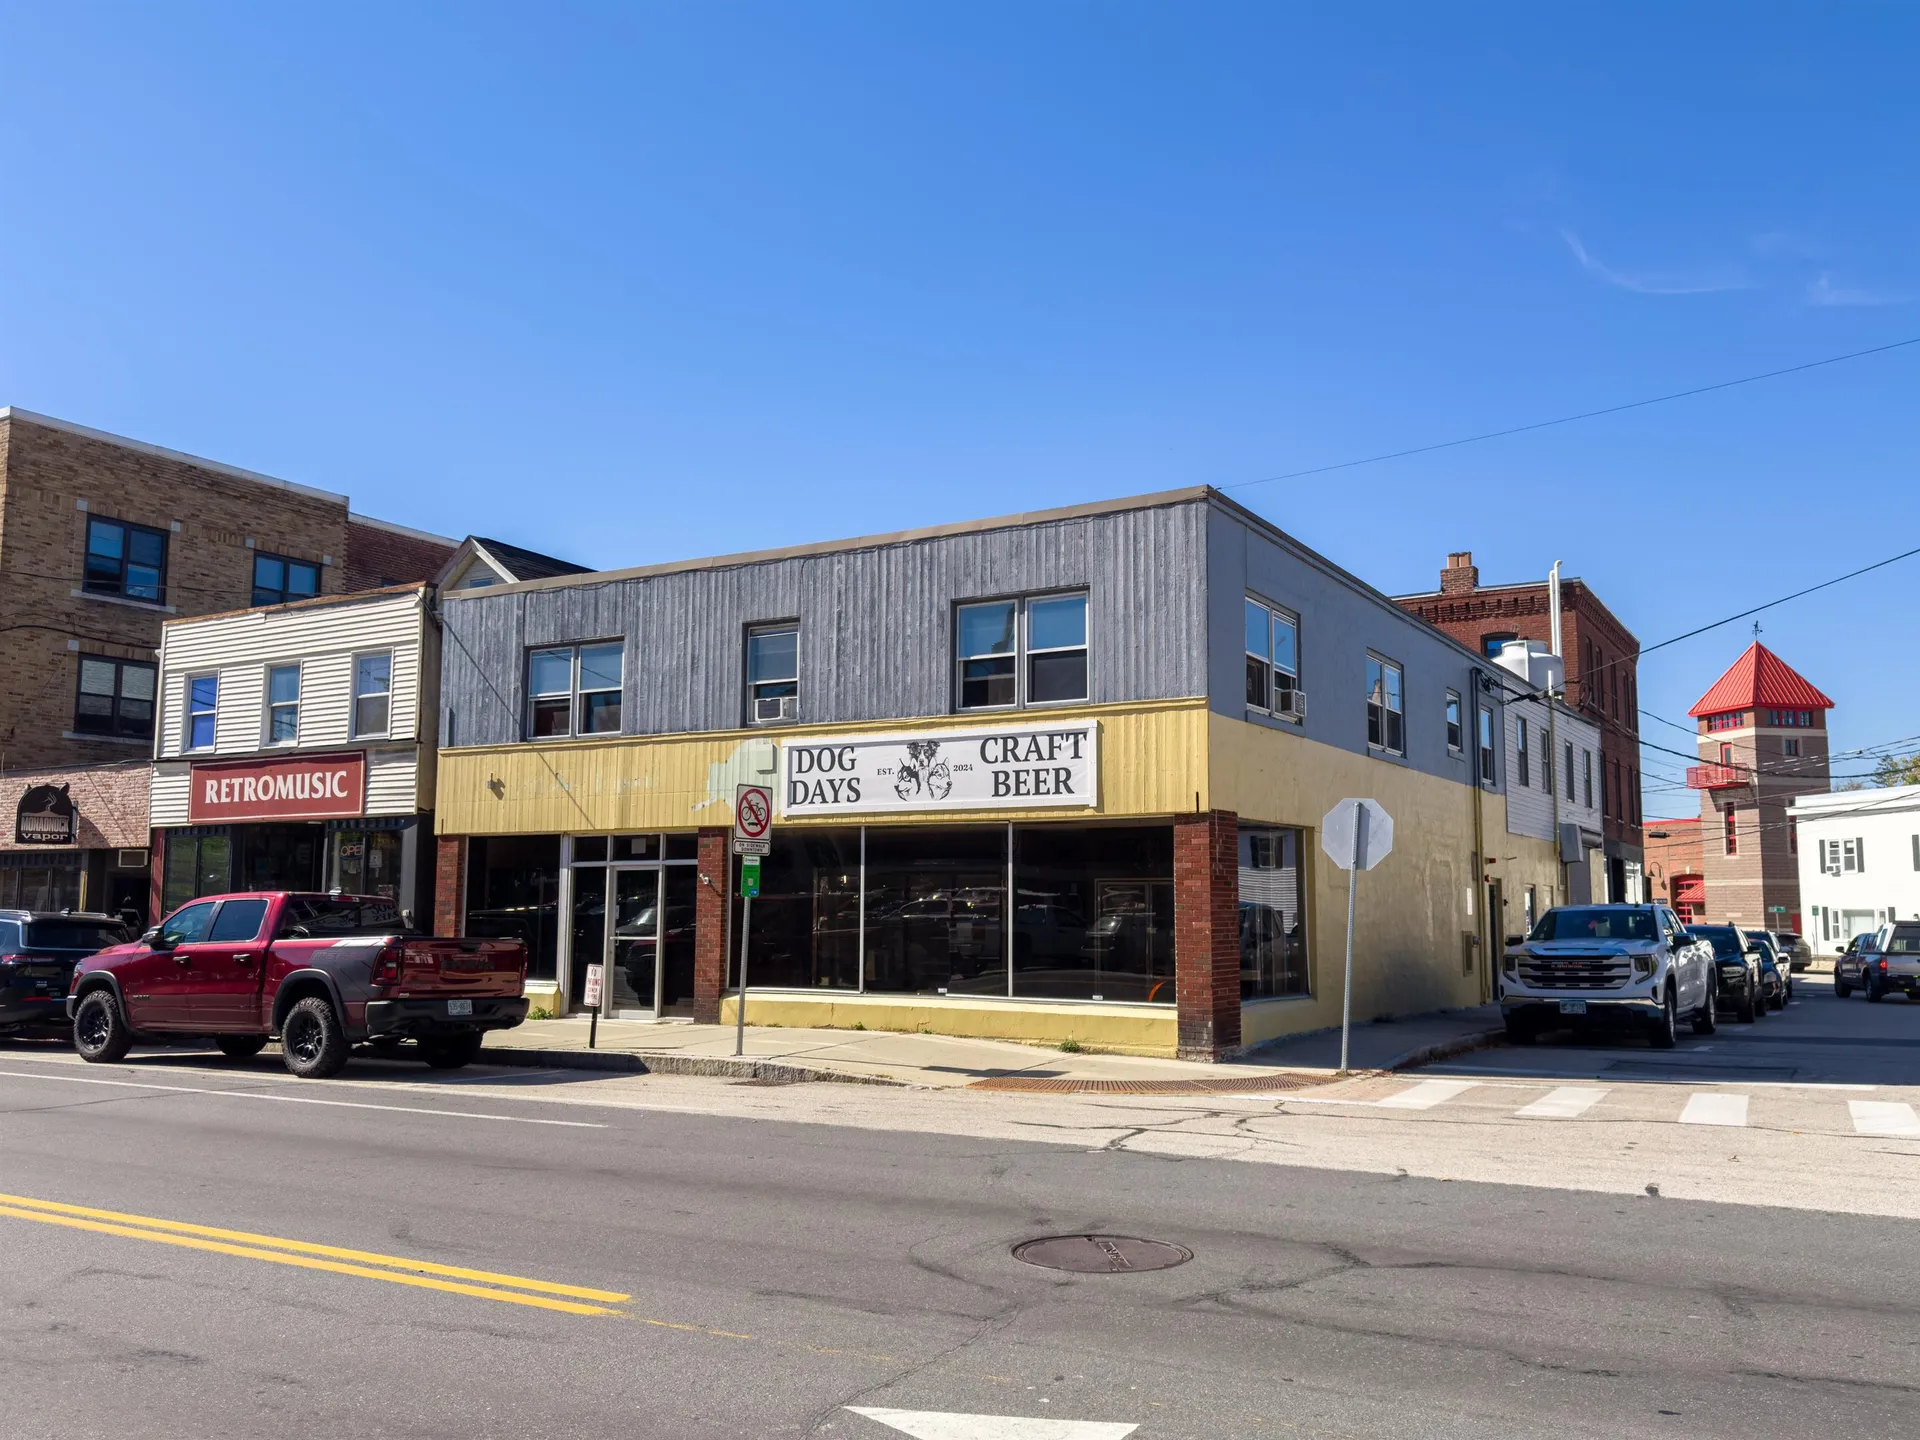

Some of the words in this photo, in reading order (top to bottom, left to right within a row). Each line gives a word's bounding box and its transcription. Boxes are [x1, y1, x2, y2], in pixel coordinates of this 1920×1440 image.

[795, 746, 857, 774] DOG
[979, 732, 1088, 764] CRAFT
[877, 768, 895, 776] EST.
[953, 764, 974, 773] 2024
[991, 767, 1075, 798] BEER
[205, 771, 348, 804] RETROMUSIC
[790, 777, 861, 806] DAYS
[21, 816, 69, 833] MONADNOCK
[22, 833, 68, 841] vapor
[341, 845, 363, 857] OPE
